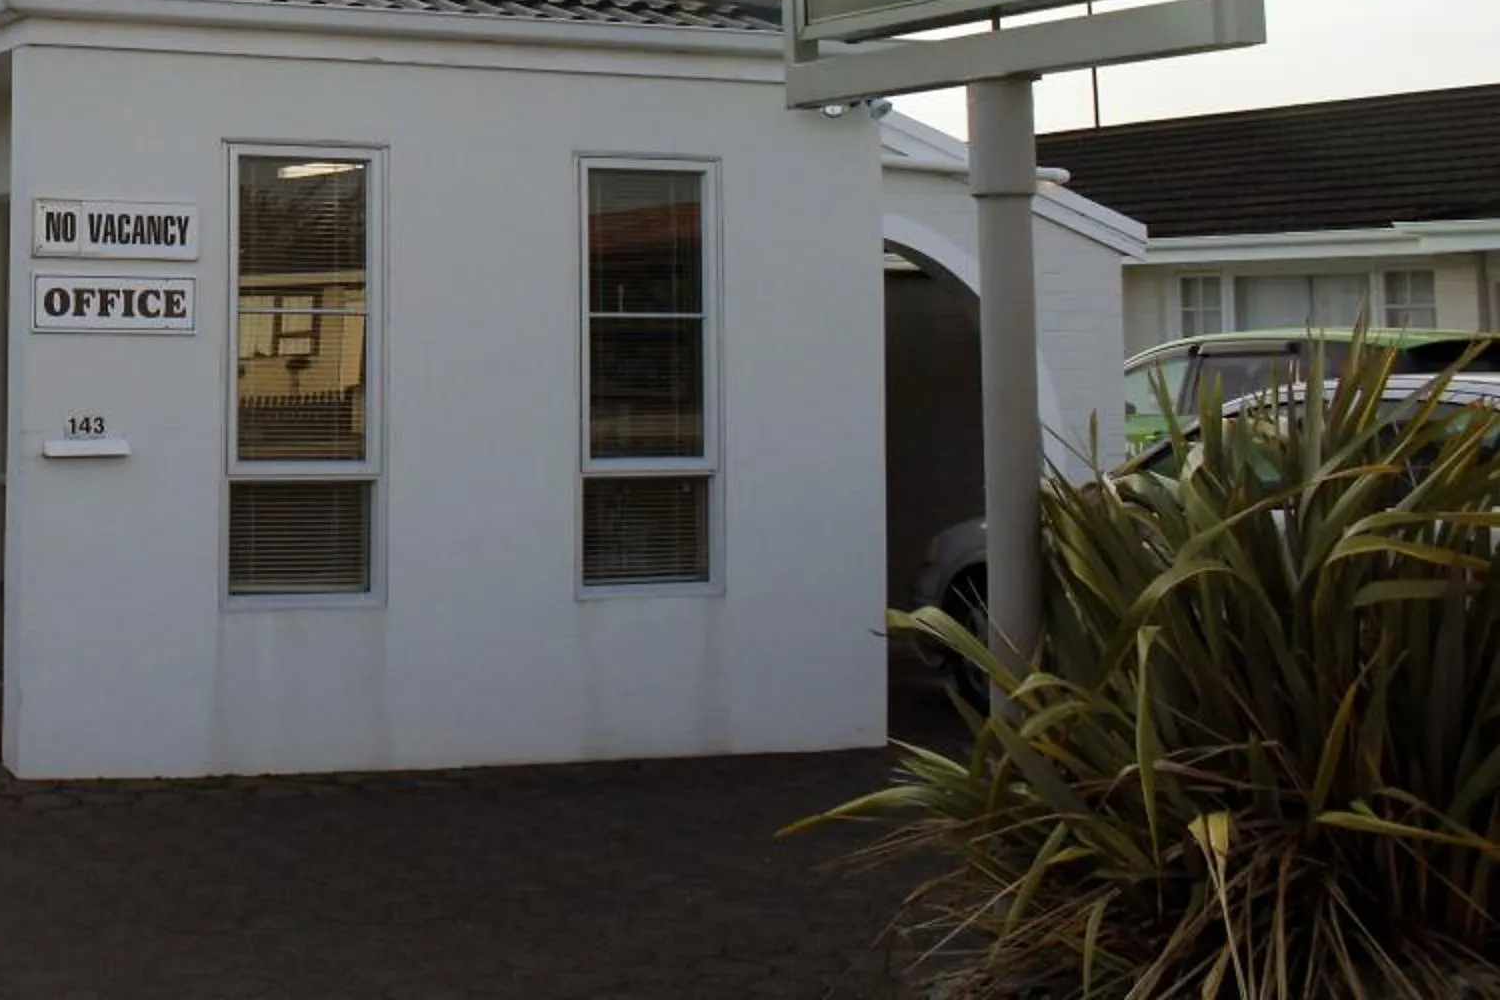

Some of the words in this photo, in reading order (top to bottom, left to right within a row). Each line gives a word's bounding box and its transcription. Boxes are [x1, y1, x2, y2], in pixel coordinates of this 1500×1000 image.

[45, 211, 77, 243] NO
[88, 213, 189, 246] VACANCY
[43, 287, 187, 319] OFFICE
[68, 417, 105, 436] 143
